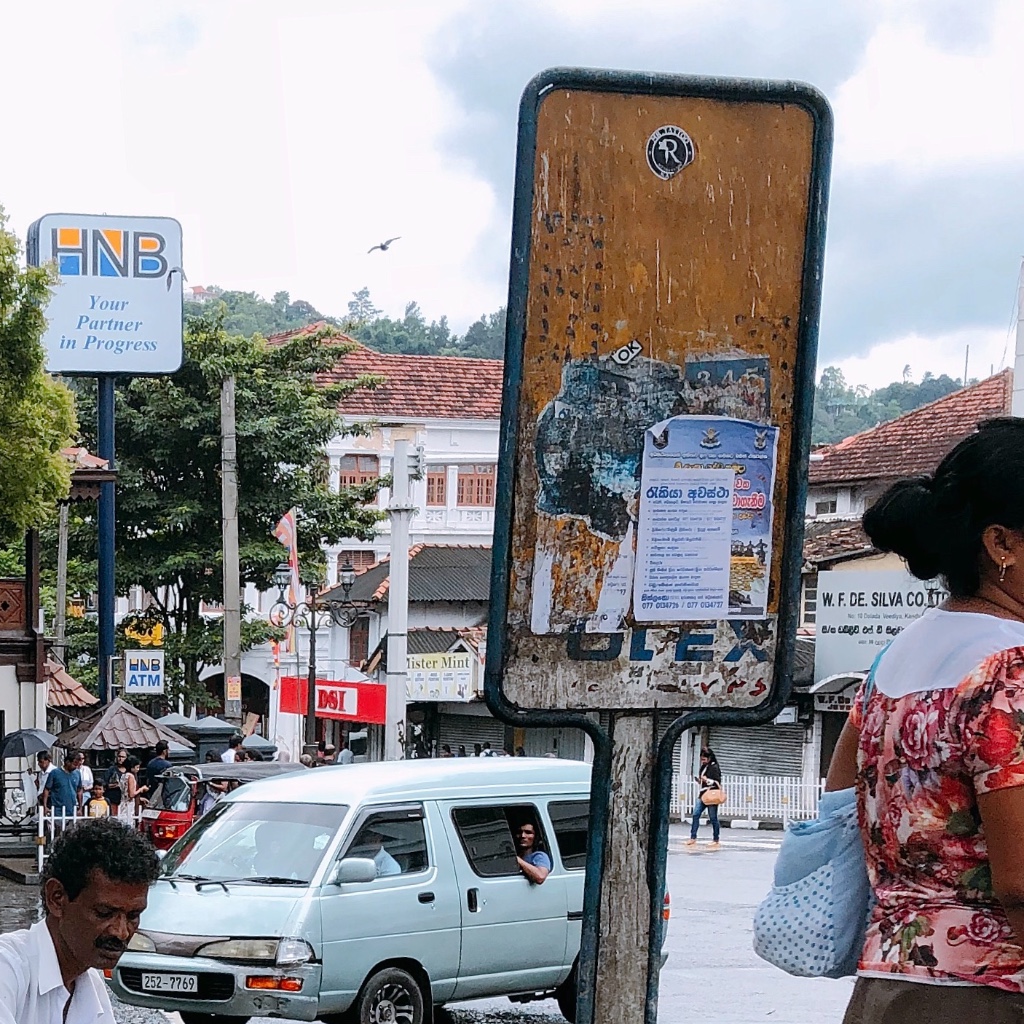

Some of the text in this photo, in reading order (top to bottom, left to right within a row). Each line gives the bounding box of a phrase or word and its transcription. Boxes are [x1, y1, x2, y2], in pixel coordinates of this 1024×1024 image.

[51, 227, 169, 279] HNB
[88, 295, 130, 312] Your
[76, 315, 144, 332] Partner
[59, 335, 158, 355] in Progress
[617, 342, 641, 364] OK
[646, 486, 729, 500] රැකියා අවස්ථා
[822, 592, 835, 607] W.
[838, 592, 847, 607] F.
[849, 592, 868, 607] DE.
[871, 592, 903, 607] SILVA
[129, 658, 161, 671] HNB
[441, 656, 470, 669] Mint
[128, 674, 160, 687] ATM
[317, 689, 346, 712] DSI
[144, 974, 195, 991] 252-7769
